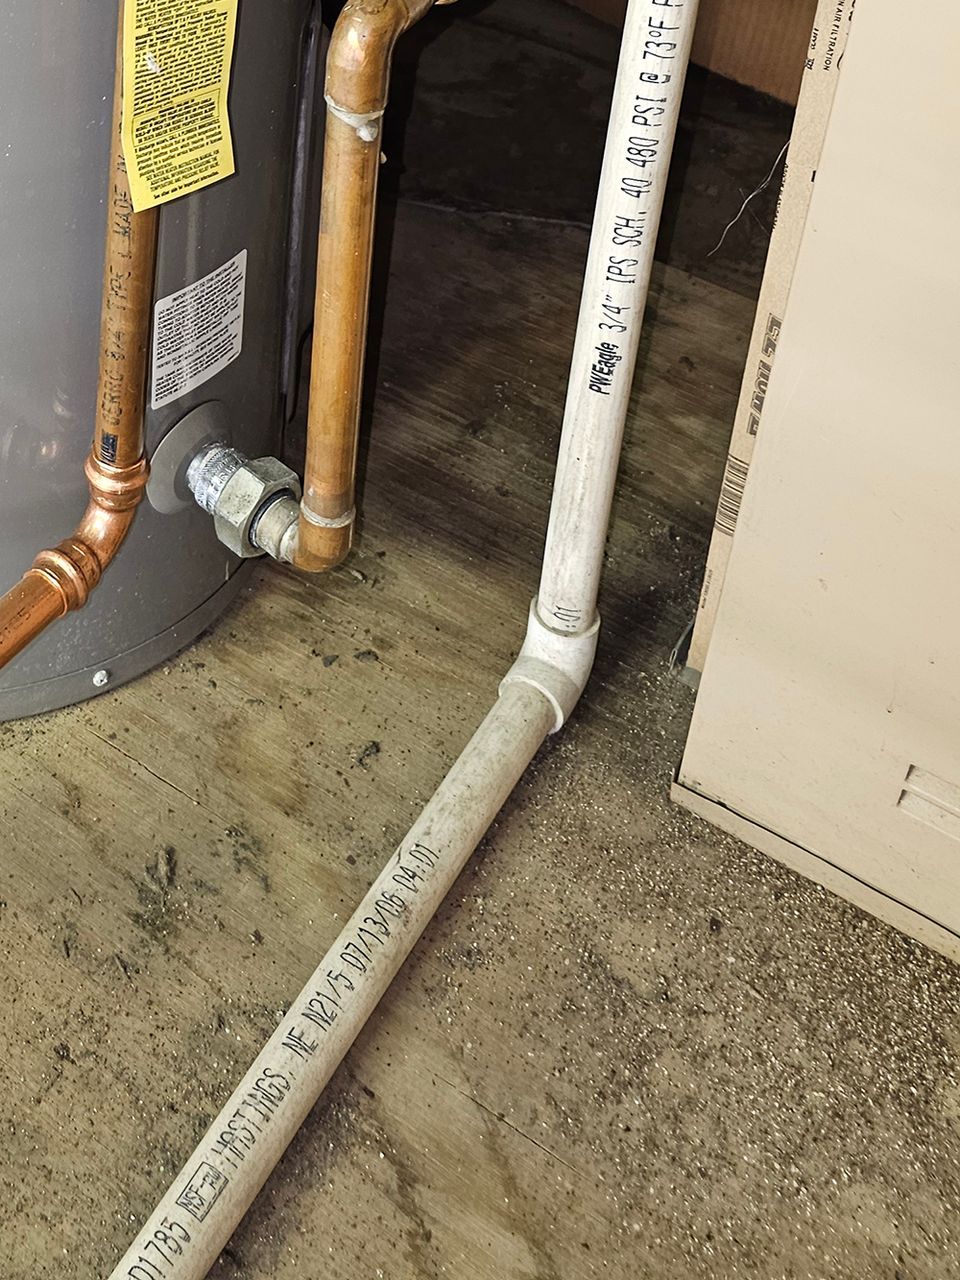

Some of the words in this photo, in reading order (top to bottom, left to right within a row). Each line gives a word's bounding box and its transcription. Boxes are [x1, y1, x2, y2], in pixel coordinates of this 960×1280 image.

[834, 8, 842, 22] AIR
[823, 24, 839, 71] FILTRATION
[639, 71, 671, 84] @
[633, 96, 668, 128] PSI
[626, 135, 660, 169] 480
[621, 176, 651, 199] 40
[607, 255, 637, 284] IPS
[589, 340, 618, 395] PWEagle
[282, 1026, 319, 1061] NE
[301, 970, 355, 1032] N21/5
[340, 891, 406, 973] 07/13/06
[392, 843, 440, 894] 04:01
